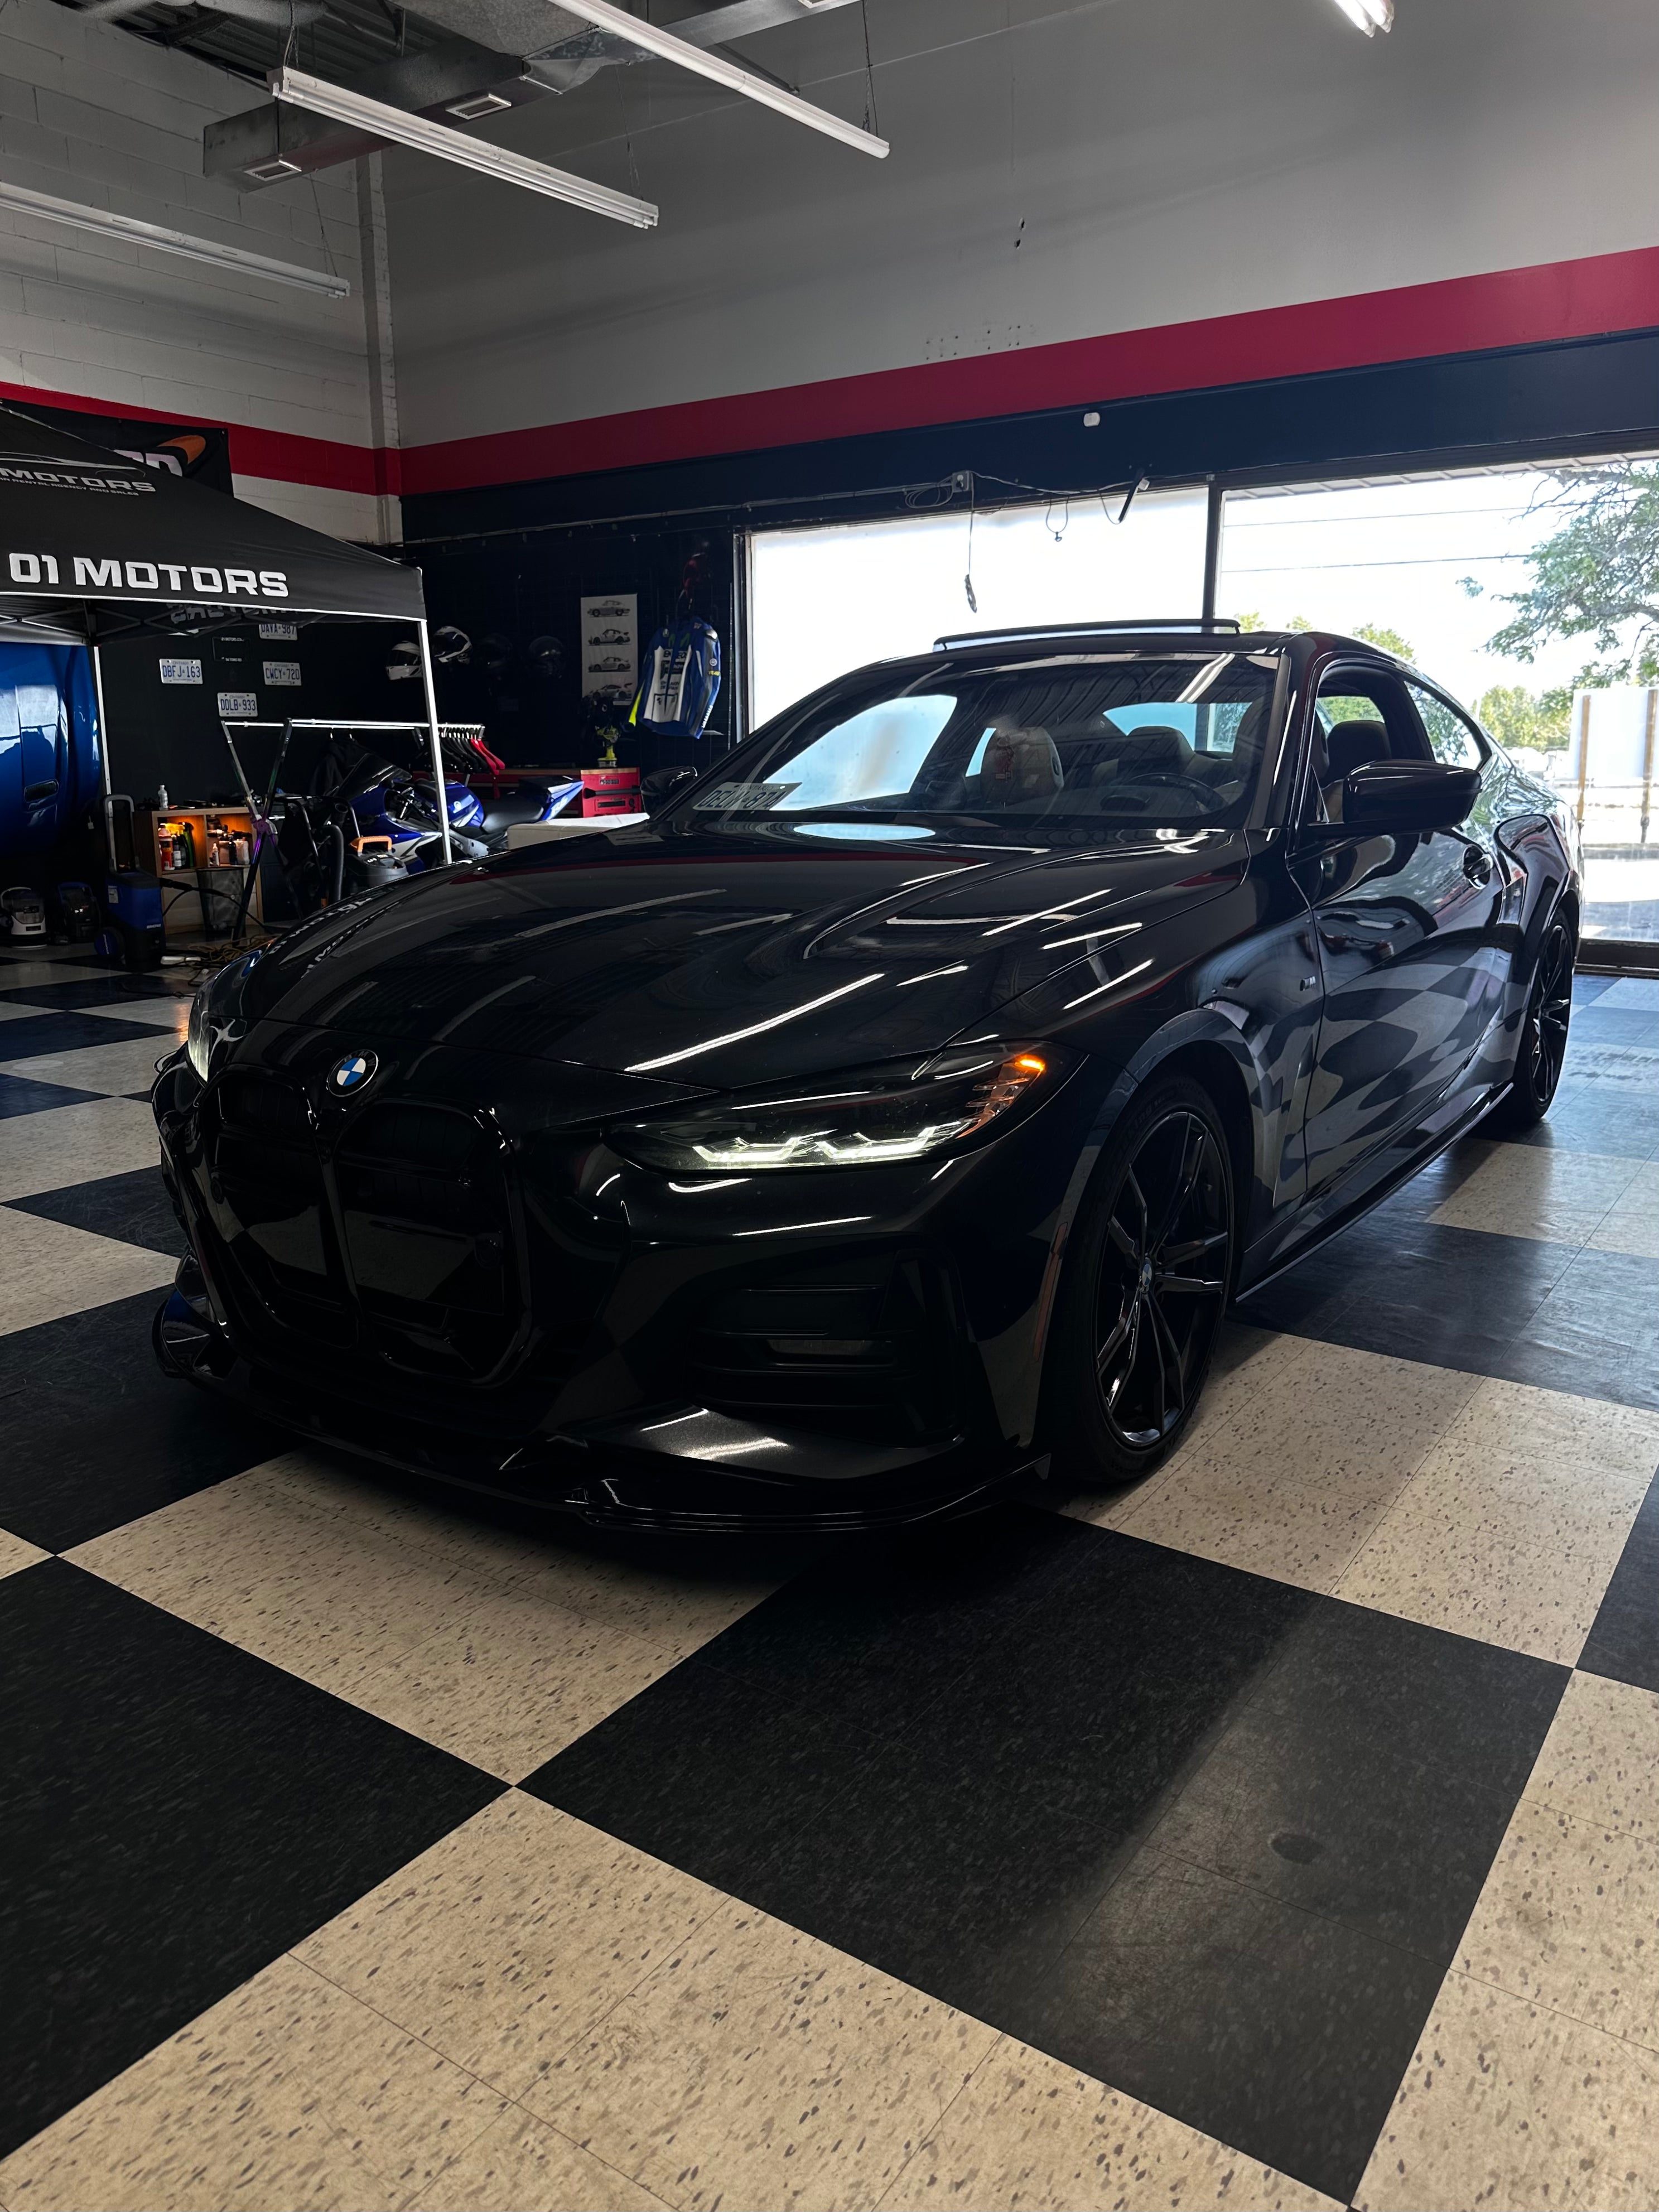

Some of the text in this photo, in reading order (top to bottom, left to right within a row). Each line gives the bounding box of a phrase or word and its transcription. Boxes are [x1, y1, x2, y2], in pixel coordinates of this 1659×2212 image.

[0, 468, 156, 492] MOTORS
[9, 553, 289, 597] 01 MOTORS
[162, 665, 200, 678] DBFJ 163
[266, 668, 300, 680] CWCY 720
[242, 699, 256, 711] 933
[344, 1050, 376, 1067] BMW
